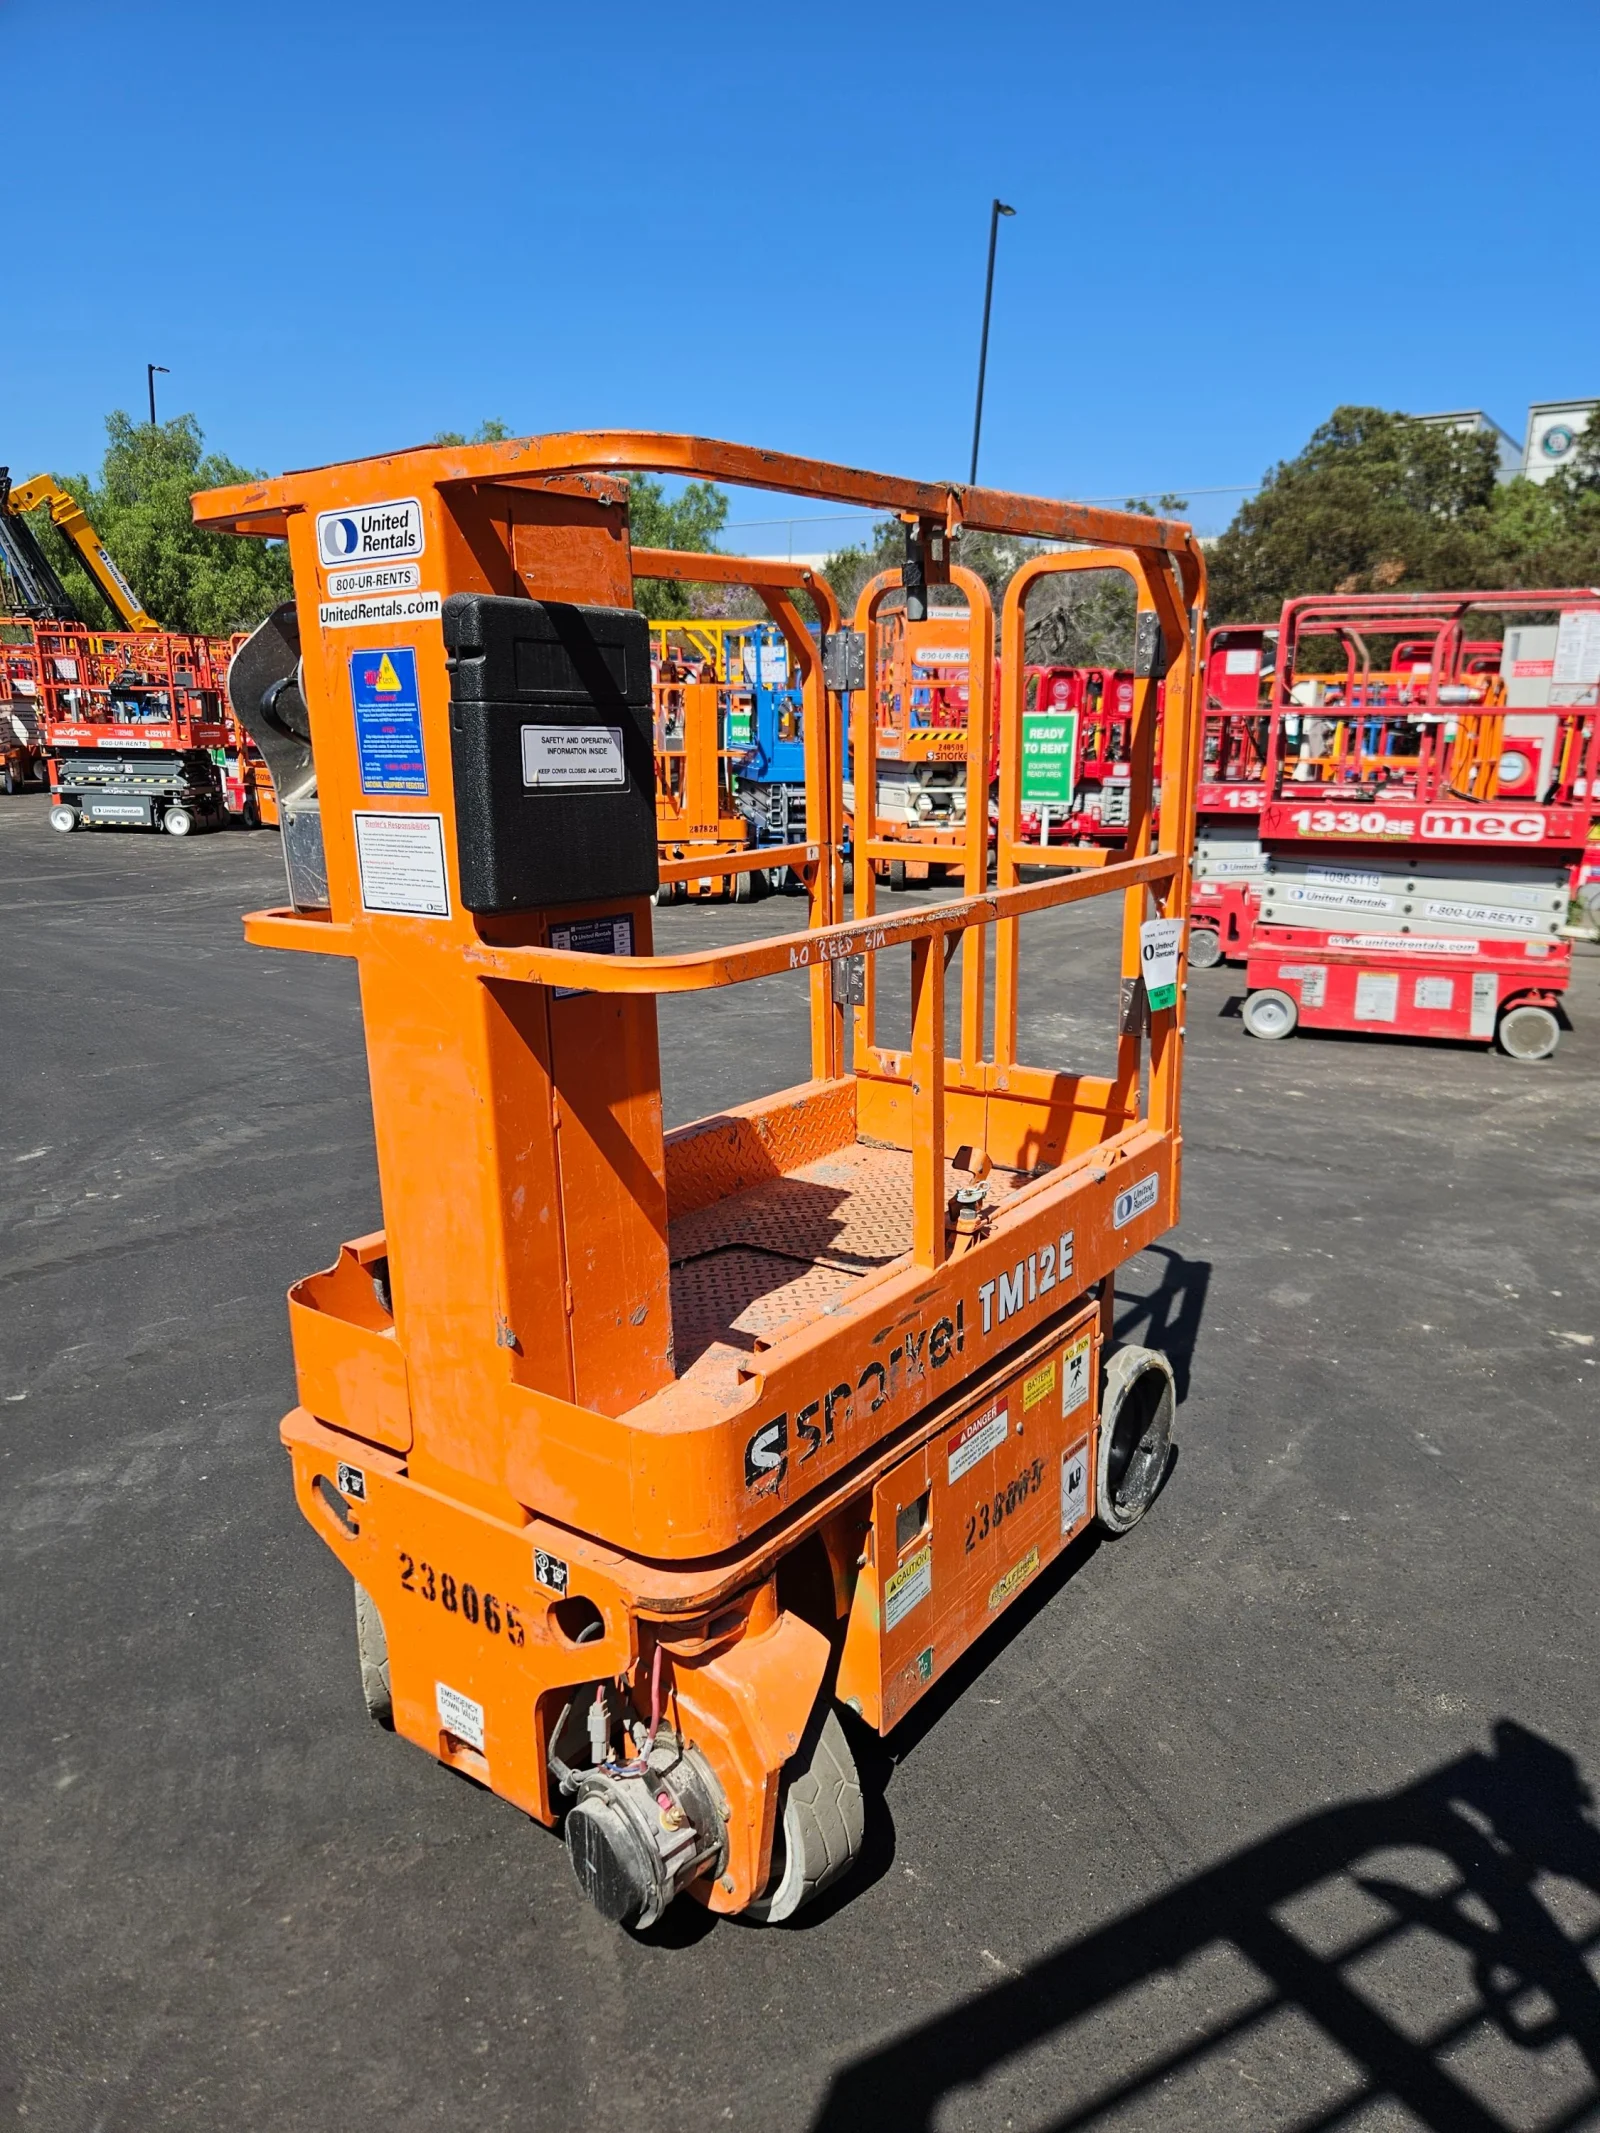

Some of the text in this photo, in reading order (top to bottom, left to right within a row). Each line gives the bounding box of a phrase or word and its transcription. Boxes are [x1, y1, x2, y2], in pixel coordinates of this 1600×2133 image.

[361, 510, 409, 533] United
[363, 530, 416, 552] Rentals
[106, 562, 123, 584] United
[336, 570, 411, 591] 800-UR-RENTS
[320, 600, 439, 622] UnitedRentals.com
[54, 728, 92, 736] SKYJACK
[541, 736, 564, 744] SAFETY
[1029, 728, 1066, 739] READY
[1024, 743, 1070, 754] TO RENT
[88, 764, 116, 772] SKYJACK
[1426, 816, 1541, 836] mec
[1306, 892, 1388, 909] United Rentals
[1428, 904, 1535, 926] 1-800-UR-RENTS
[819, 936, 854, 961] REED
[1155, 940, 1176, 950] United
[1155, 950, 1176, 958] Rentals
[1330, 935, 1476, 952] www.unitedrentals.com
[1134, 1180, 1154, 1200] United
[1134, 1192, 1154, 1208] Rentals
[979, 1229, 1074, 1335] TM12E
[1027, 1366, 1052, 1392] BATTERY
[966, 1404, 998, 1438] DANGER
[896, 1550, 927, 1586] CAUTION
[399, 1552, 525, 1648] 238065
[440, 1687, 478, 1714] EMERGENCY
[440, 1696, 479, 1725] DOWN VALVE
